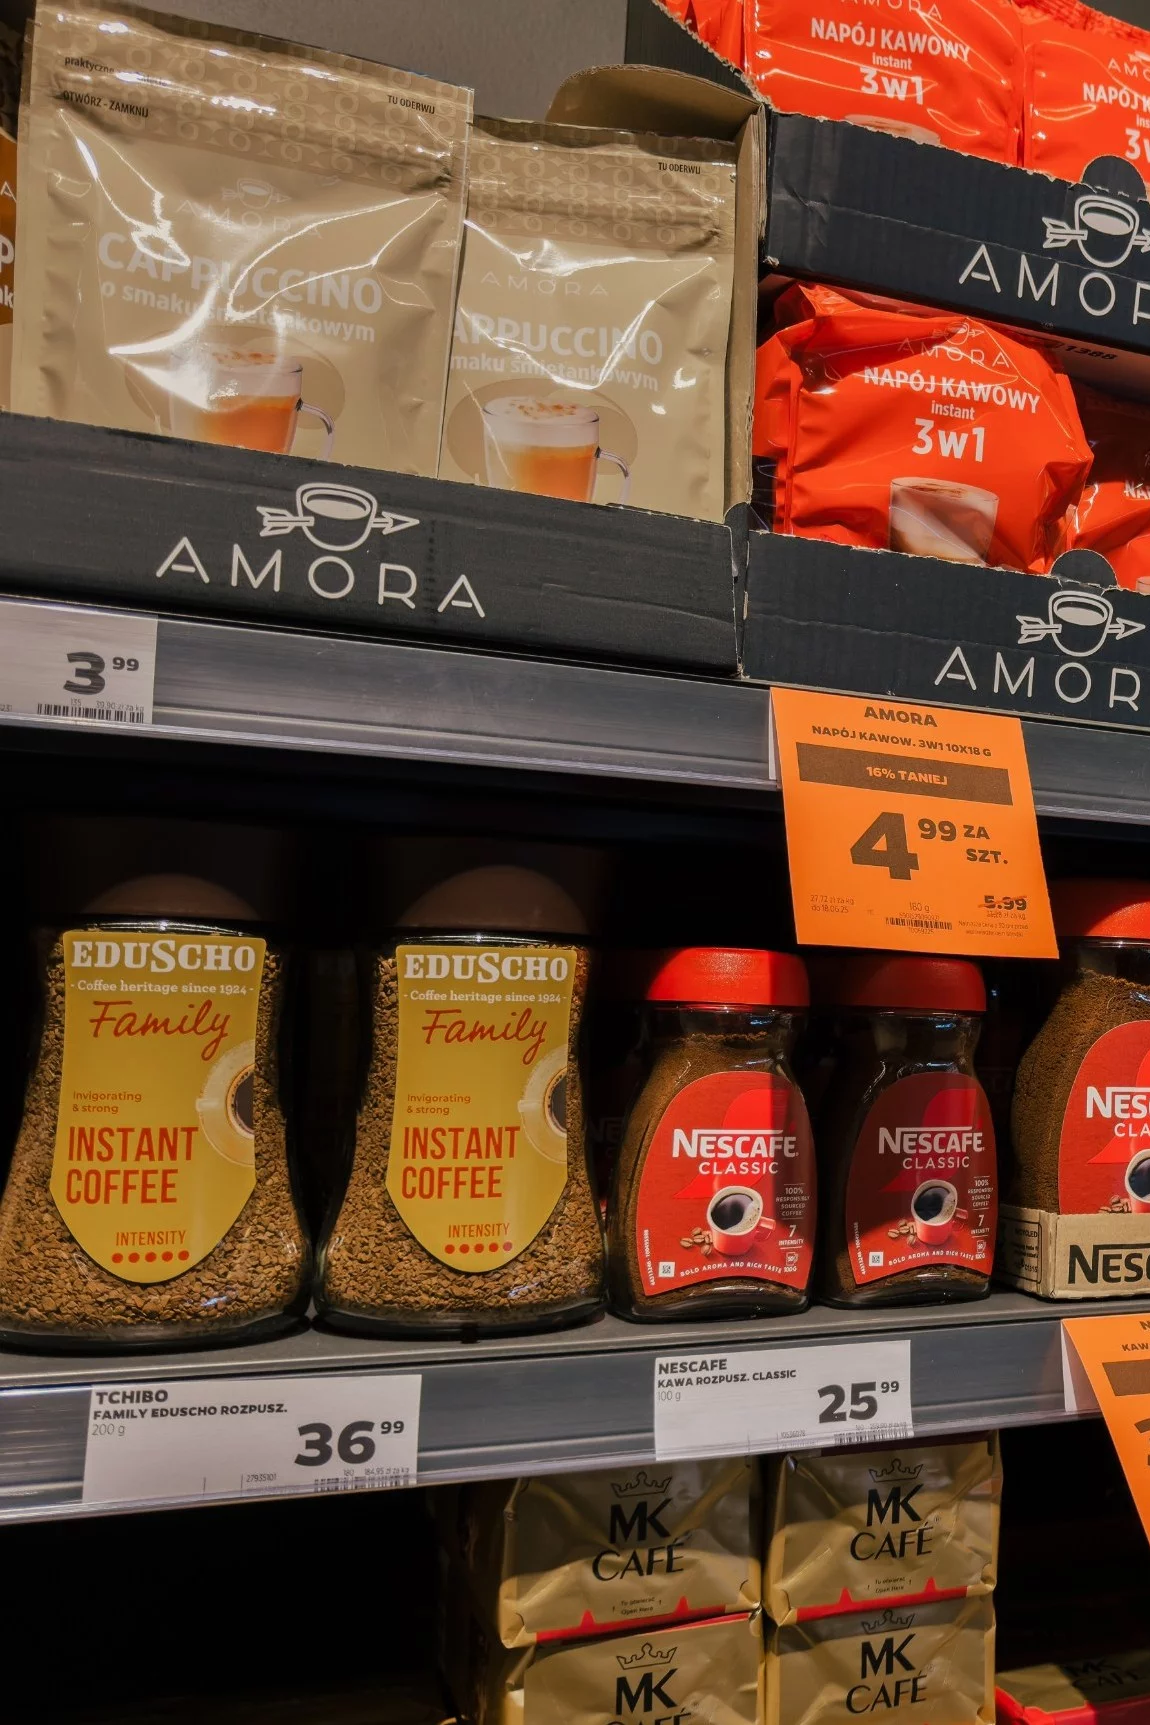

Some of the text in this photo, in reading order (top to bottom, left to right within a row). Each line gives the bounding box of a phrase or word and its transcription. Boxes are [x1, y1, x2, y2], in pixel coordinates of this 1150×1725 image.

[811, 17, 970, 62] NAPÓJ KAWOWY
[872, 52, 912, 70] instant
[62, 90, 149, 119] OTWÓRZ ZAMKNIJ
[400, 97, 436, 115] ODERWIJ
[1083, 82, 1139, 110] NAPÓJ
[176, 200, 323, 240] AMORA
[98, 231, 383, 315] CAPPUCCINO
[480, 270, 610, 297] AMORA
[121, 284, 198, 317] smaku
[452, 311, 663, 365] APPUCCINO
[898, 338, 1010, 369] AMORA
[864, 366, 1041, 414] NAPÓJ KAWOWY
[931, 400, 975, 420] instant
[155, 536, 487, 619] AMORA
[63, 652, 139, 695] 3 99
[864, 706, 938, 728] AMORA
[812, 725, 992, 757] NAPÓJ KAWOW. 3W1 10X18 G
[866, 765, 948, 786] 16% TANIEJ
[850, 811, 990, 881] 4 99 ZA
[966, 848, 1009, 865] SZT.
[984, 895, 1028, 911] 5.99
[71, 939, 255, 973] EDUSCHO
[403, 951, 569, 983] EDUSCHO
[77, 979, 247, 996] Coffee heritage since 1924
[410, 989, 561, 1005] Coffee heritage since 1924
[89, 999, 232, 1062] Family
[421, 1007, 548, 1066] Family
[73, 1090, 142, 1104] Invigorating
[81, 1104, 119, 1115] strong
[407, 1093, 471, 1105] Invigorating
[416, 1106, 450, 1116] strong
[68, 1126, 199, 1162] INSTANT
[403, 1126, 521, 1160] INSTANT
[698, 1161, 779, 1176] CLASSIC
[902, 1156, 970, 1170] CLASSIC
[66, 1168, 179, 1205] COFFEE
[402, 1166, 504, 1200] COFFEE
[115, 1230, 187, 1247] INTENSITY
[448, 1223, 510, 1239] INTENSITY
[702, 1262, 728, 1272] AROMA
[657, 1369, 797, 1389] KAWA ROZPUSZ. CLASSIC
[658, 1358, 728, 1375] NESCAFE
[93, 1403, 288, 1421] FAMILY EDUSCHO ROZPUSZ.
[95, 1389, 169, 1405] TCHIBO
[816, 1380, 900, 1424] 25 99
[91, 1423, 115, 1437] 200
[293, 1420, 405, 1467] 36 99
[866, 1482, 922, 1527] MK
[608, 1496, 676, 1545] MK
[849, 1519, 934, 1562] CAFÉ
[592, 1532, 692, 1582] CAFÉ
[861, 1634, 916, 1681] MK
[615, 1669, 679, 1716] MK
[845, 1673, 928, 1715] CAFÉ
